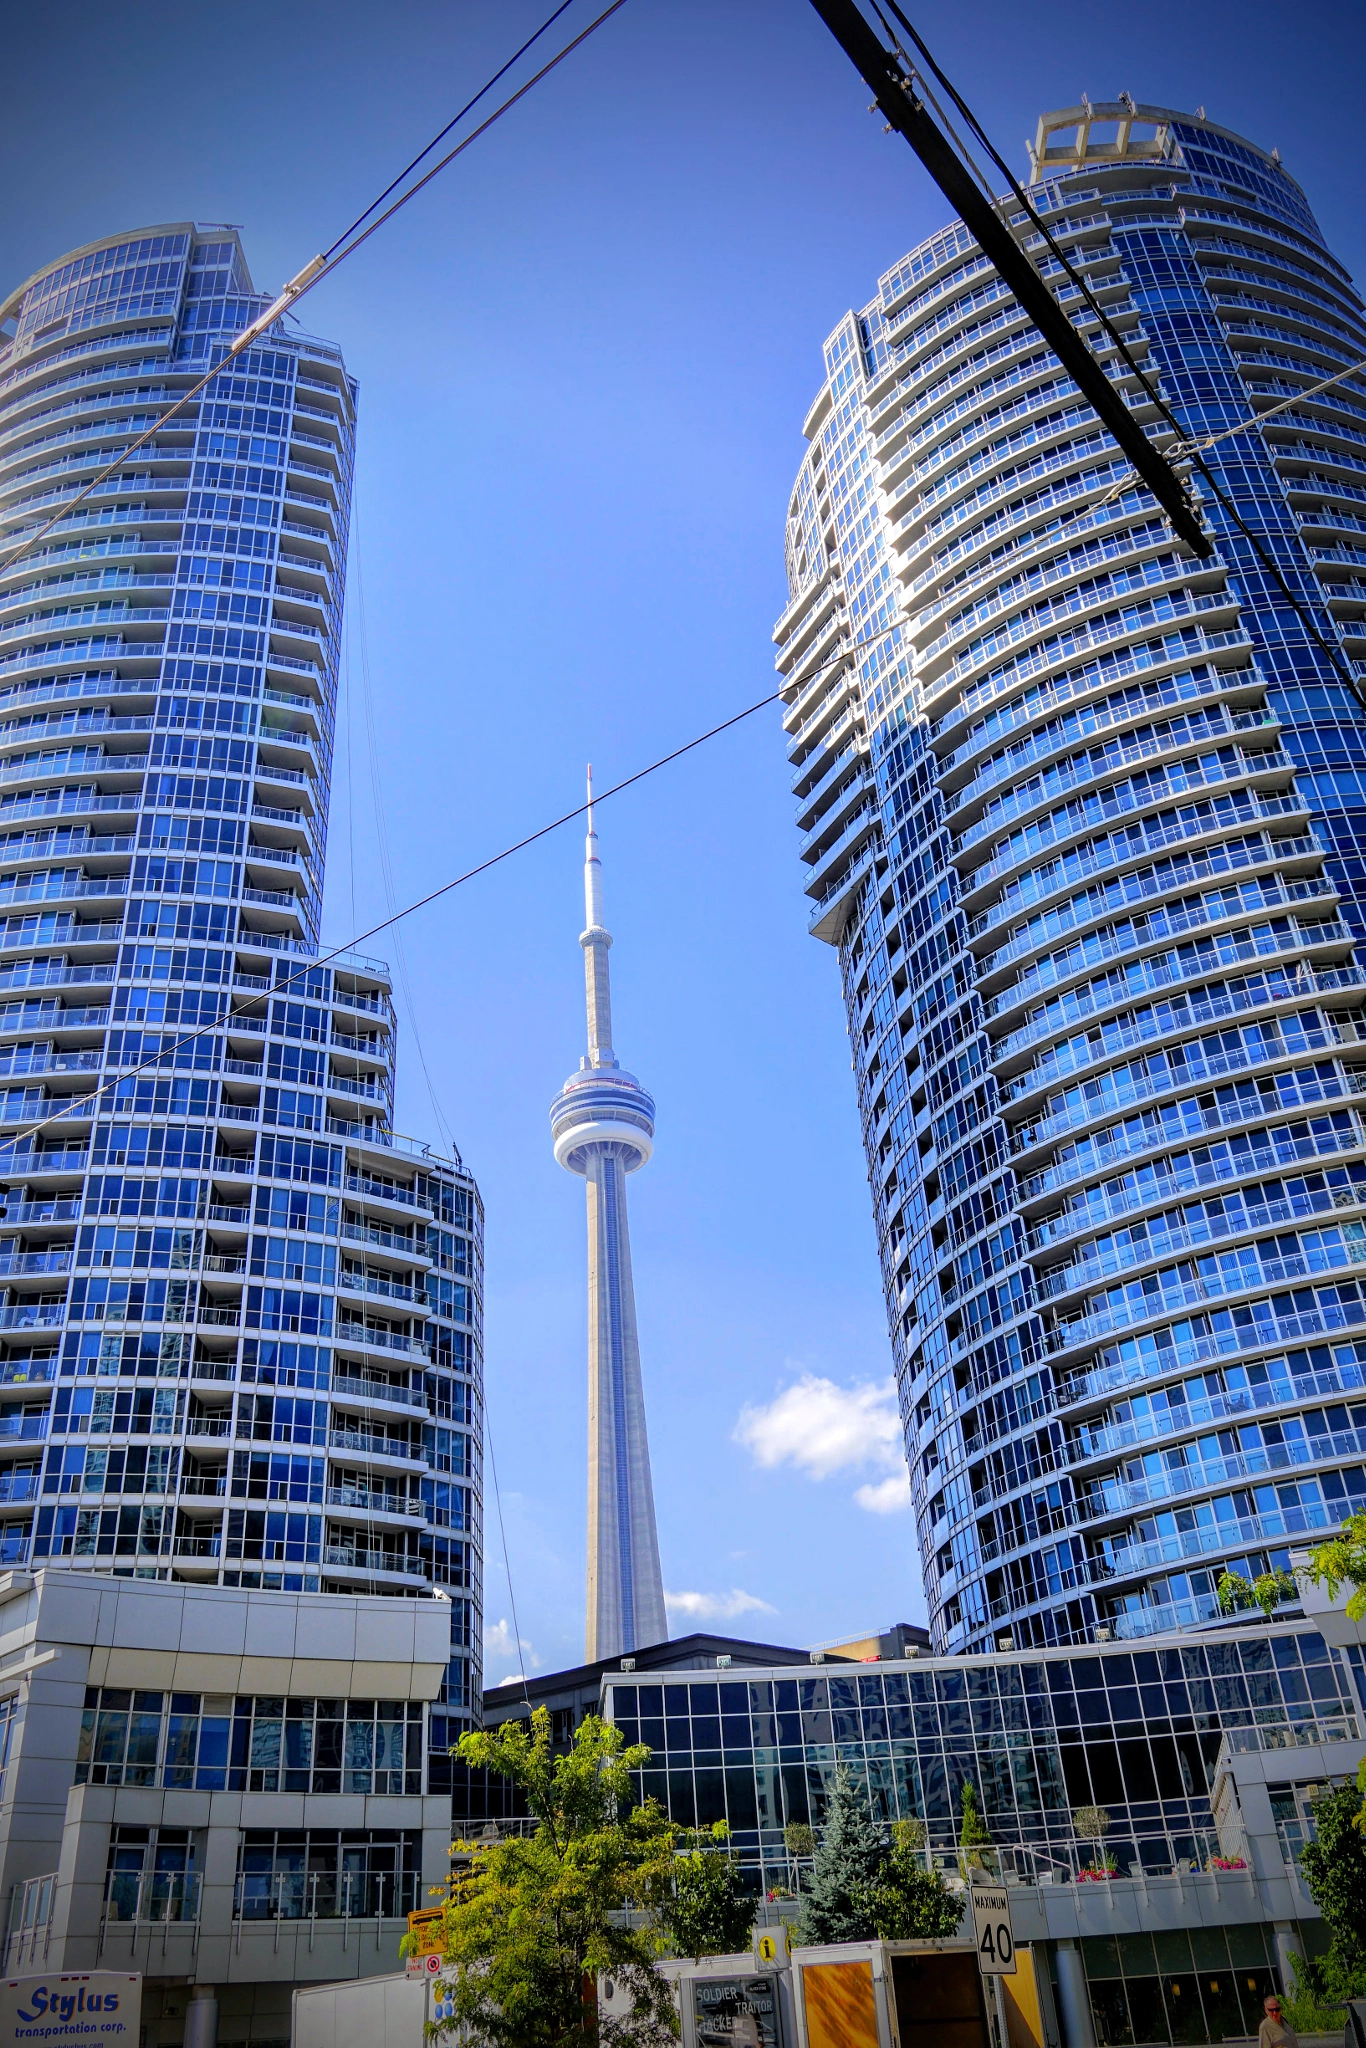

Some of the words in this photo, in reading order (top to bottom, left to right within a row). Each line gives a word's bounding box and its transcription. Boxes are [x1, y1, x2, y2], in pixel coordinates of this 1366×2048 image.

[974, 1895, 1007, 1909] MAXIMUM
[980, 1923, 1012, 1964] 40
[696, 1986, 738, 2002] SOLDIER
[16, 1986, 121, 2022] Stylus
[735, 2000, 773, 2015] TRAITOR
[15, 2021, 97, 2039] transportation
[100, 2022, 127, 2035] corp.
